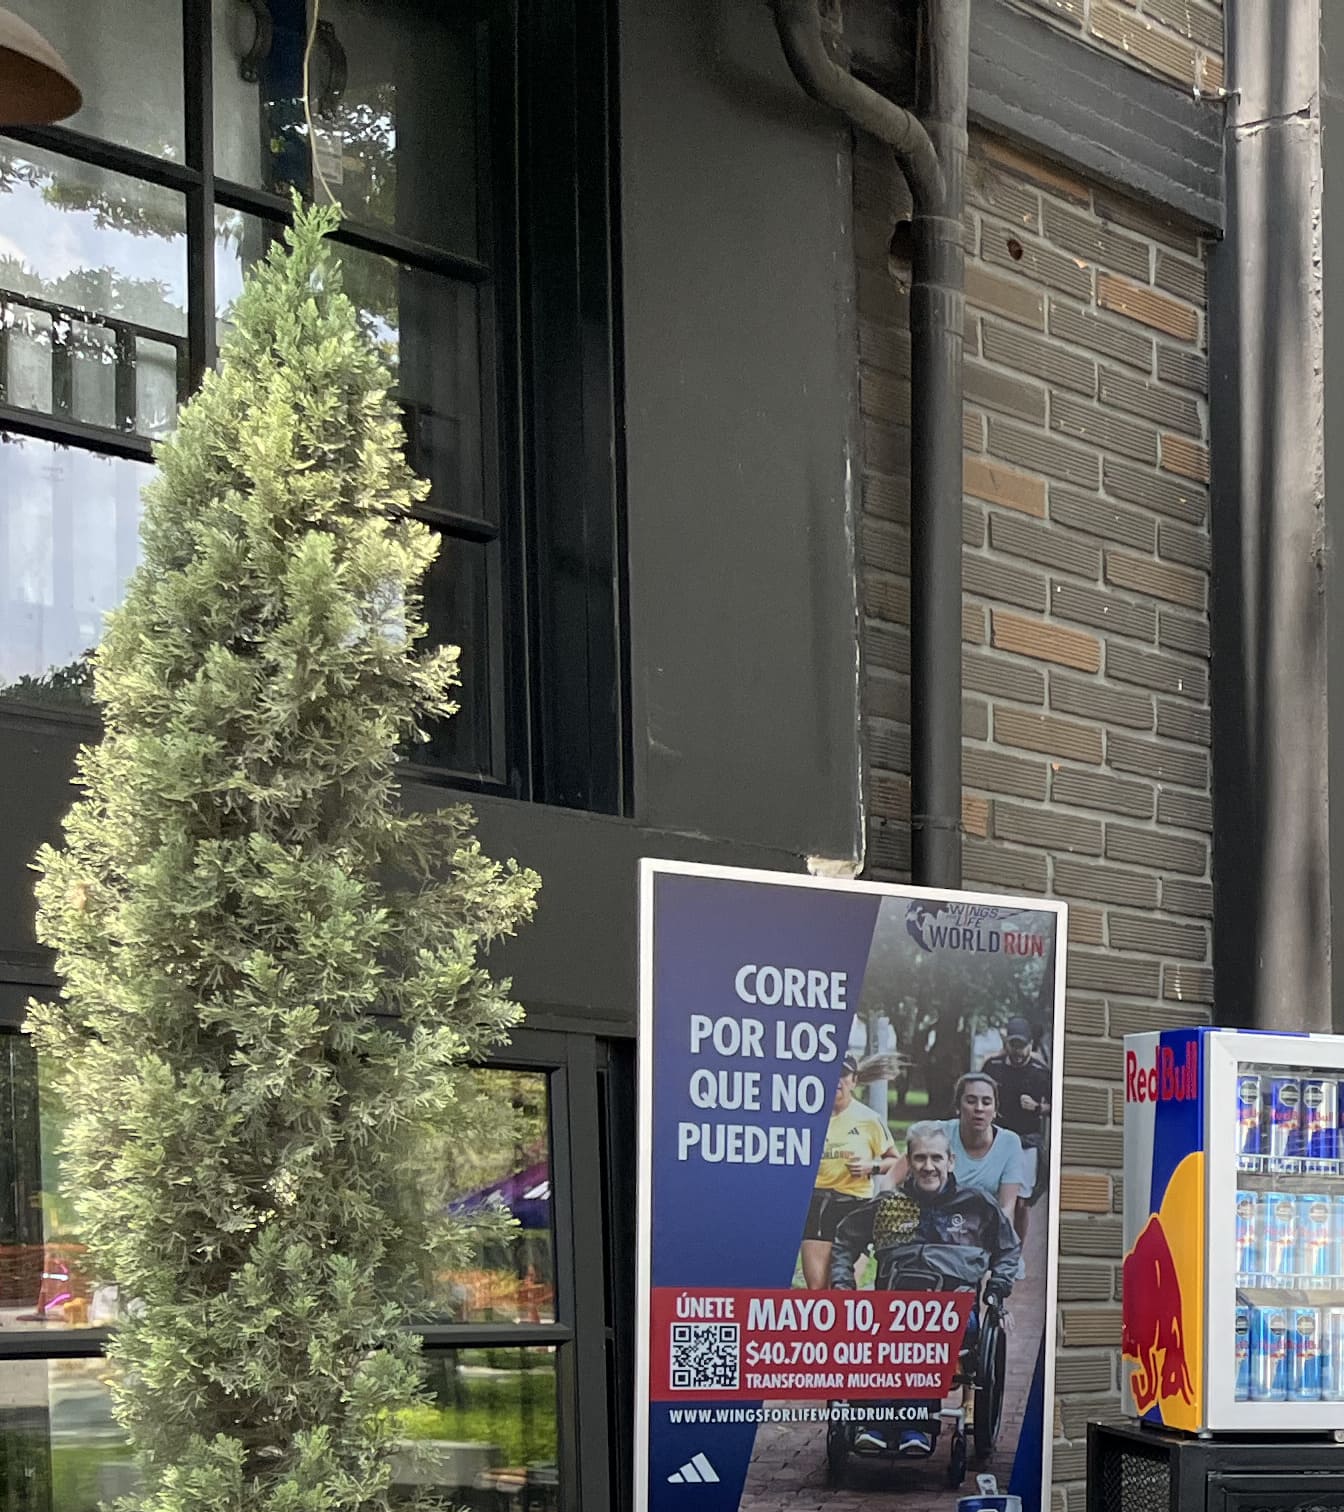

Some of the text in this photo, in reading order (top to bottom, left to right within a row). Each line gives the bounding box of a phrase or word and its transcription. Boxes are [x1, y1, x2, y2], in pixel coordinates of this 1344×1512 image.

[949, 903, 999, 918] WINGS
[930, 924, 1044, 957] WORLD RUN
[734, 964, 848, 1010] CORRE
[690, 1014, 838, 1063] POR LOS
[689, 1069, 825, 1114] QUE NO
[1126, 1040, 1198, 1103] Red Bull
[677, 1122, 811, 1166] PUEDEN
[676, 1291, 960, 1335] ÚNETE MAYO 10, 2026
[745, 1340, 949, 1367] $40.700 QUE PUEDEN
[745, 1373, 942, 1389] TRANSFORMAR MUCHAS VIDAS
[669, 1407, 929, 1424] WWW.WINGSFORLIFEWORLDRUN.COM
